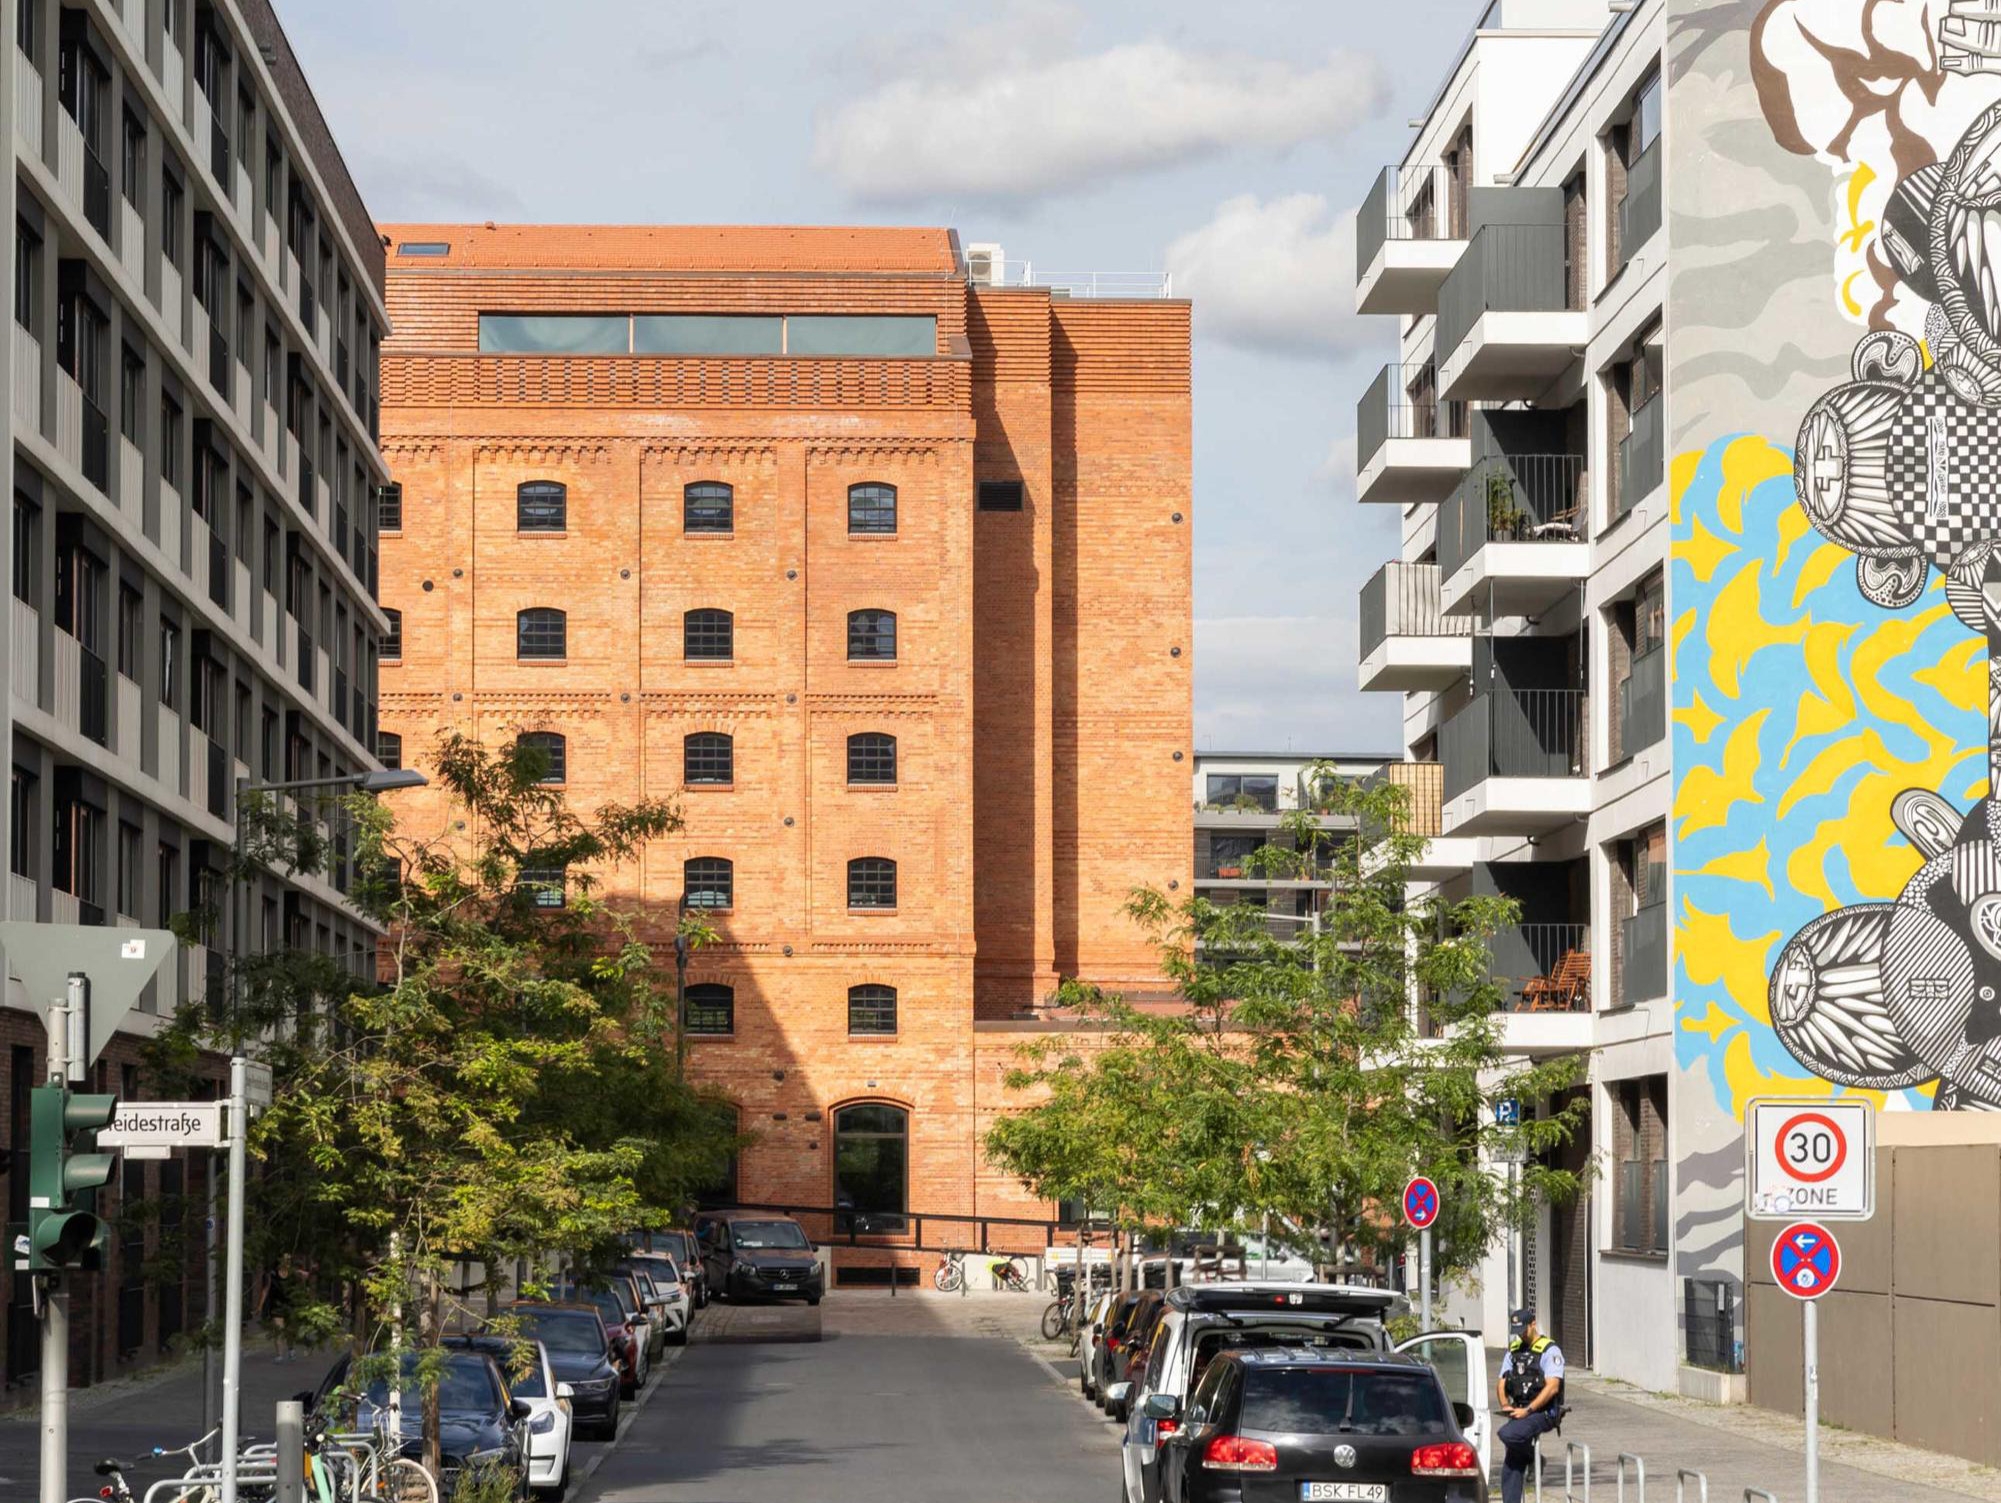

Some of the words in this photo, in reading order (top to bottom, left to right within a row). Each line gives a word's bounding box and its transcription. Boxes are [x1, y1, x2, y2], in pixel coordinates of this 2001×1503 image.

[1789, 1132, 1832, 1164] 30
[1312, 1484, 1342, 1499] BSK
[1347, 1485, 1383, 1500] FL49
